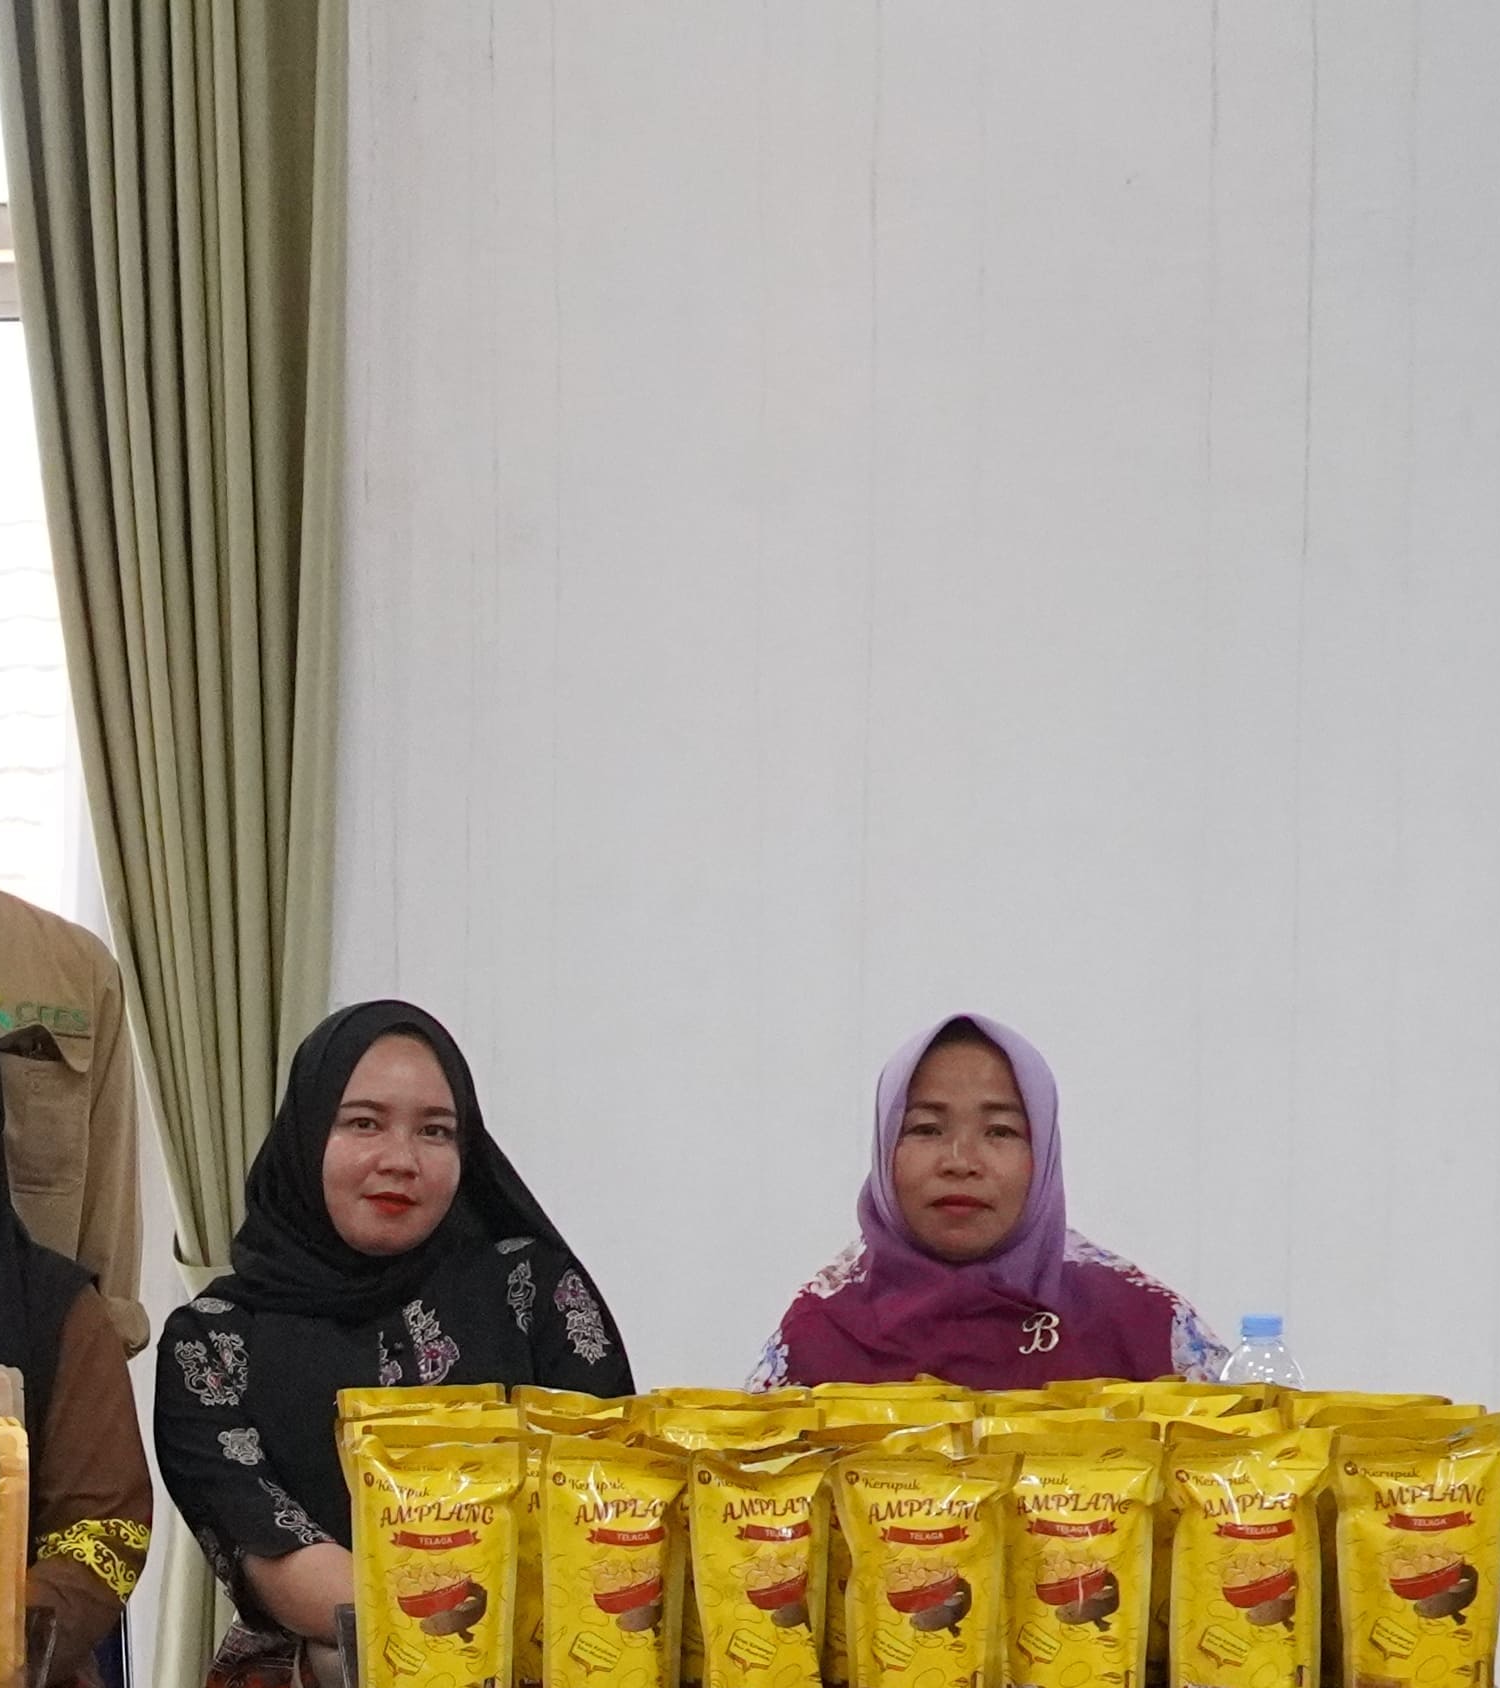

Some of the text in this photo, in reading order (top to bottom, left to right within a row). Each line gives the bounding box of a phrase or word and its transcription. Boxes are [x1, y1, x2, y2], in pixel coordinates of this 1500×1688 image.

[1019, 1311, 1059, 1355] B
[862, 1478, 920, 1493] Kerupuk
[380, 1502, 494, 1528] AMPLANG
[419, 1537, 453, 1545] TELAGA
